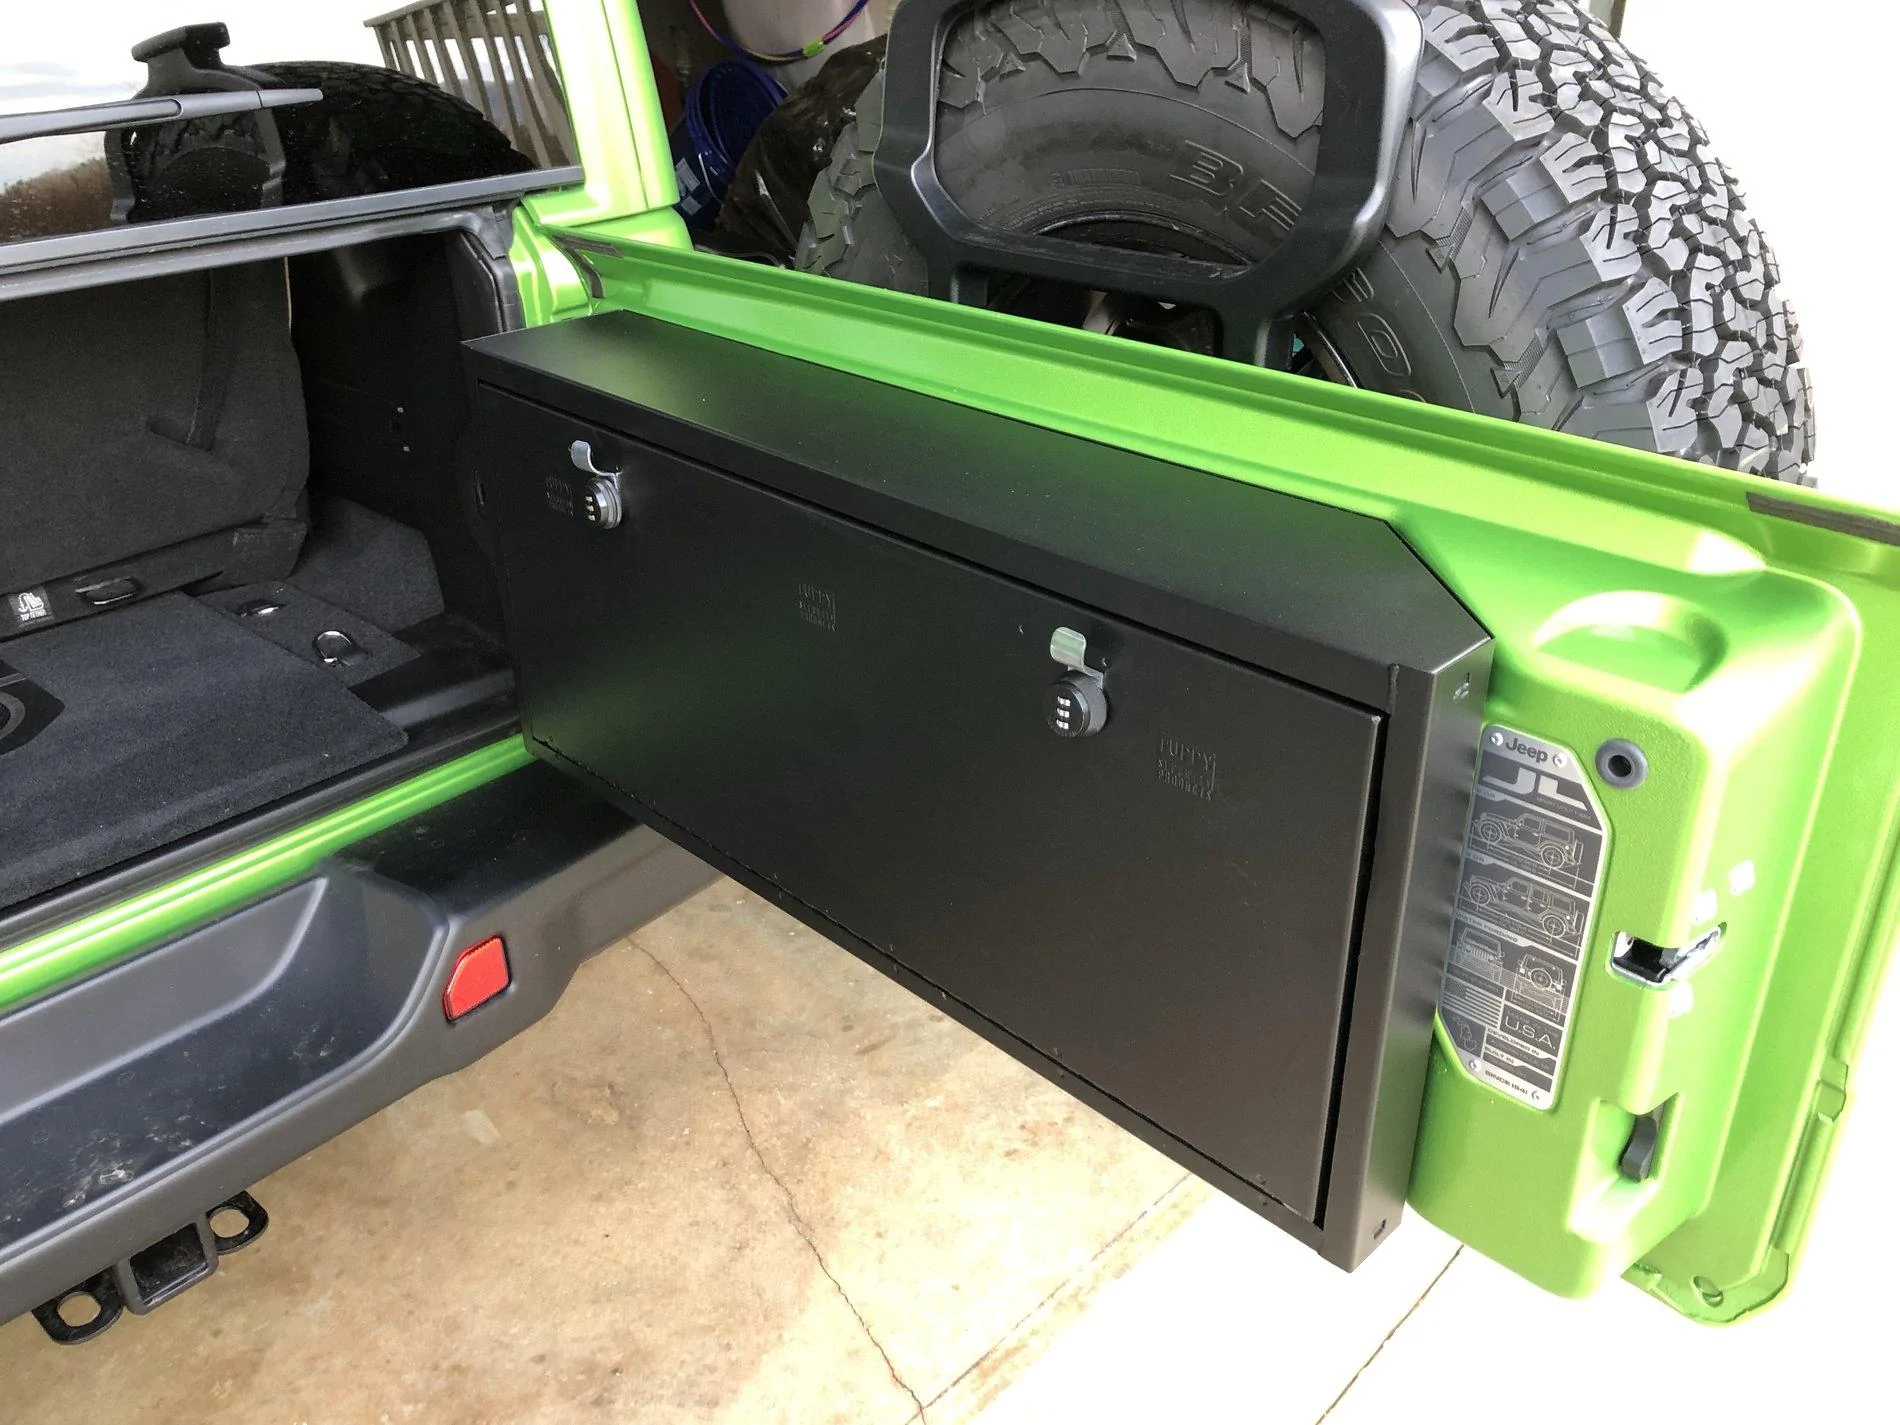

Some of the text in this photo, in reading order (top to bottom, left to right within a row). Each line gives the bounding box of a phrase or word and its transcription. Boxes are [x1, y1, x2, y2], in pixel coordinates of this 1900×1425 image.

[1505, 738, 1549, 763] Jeep
[1481, 767, 1588, 811] JL
[1485, 1069, 1511, 1086] SINCE
